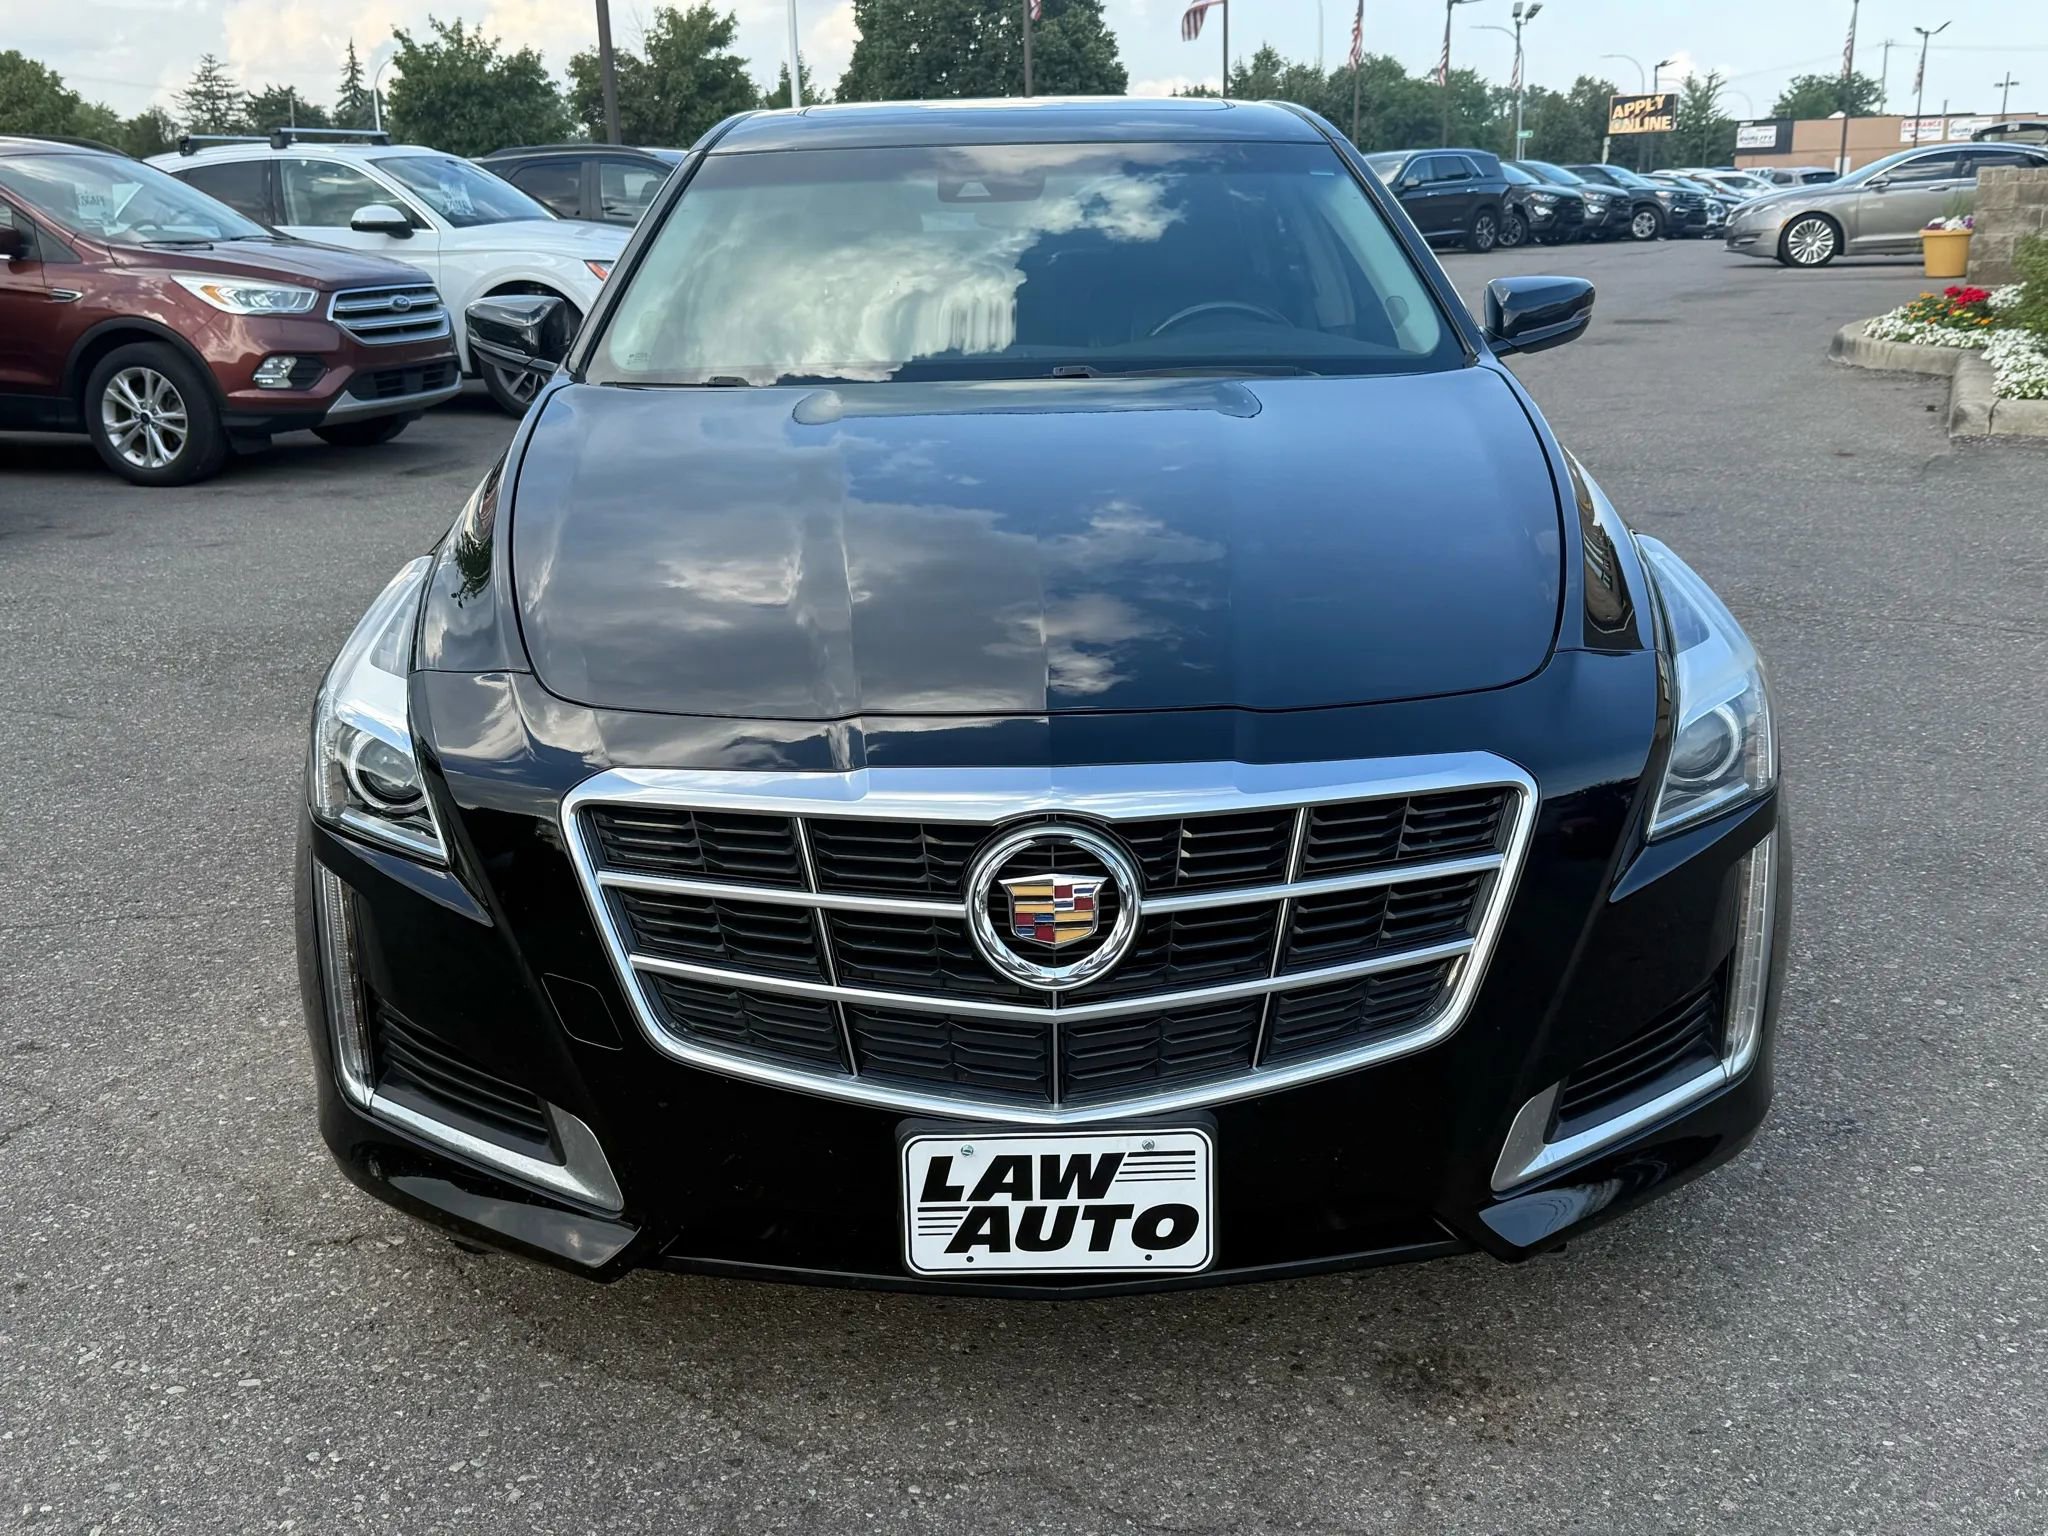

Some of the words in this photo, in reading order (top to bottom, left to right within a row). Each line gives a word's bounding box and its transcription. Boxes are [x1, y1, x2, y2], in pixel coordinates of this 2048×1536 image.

[1612, 95, 1665, 119] APPLY
[1607, 115, 1672, 131] ONLINE
[1903, 120, 1942, 128] ENRANCE
[920, 1152, 1126, 1202] LAW
[944, 1203, 1199, 1253] AUTO
